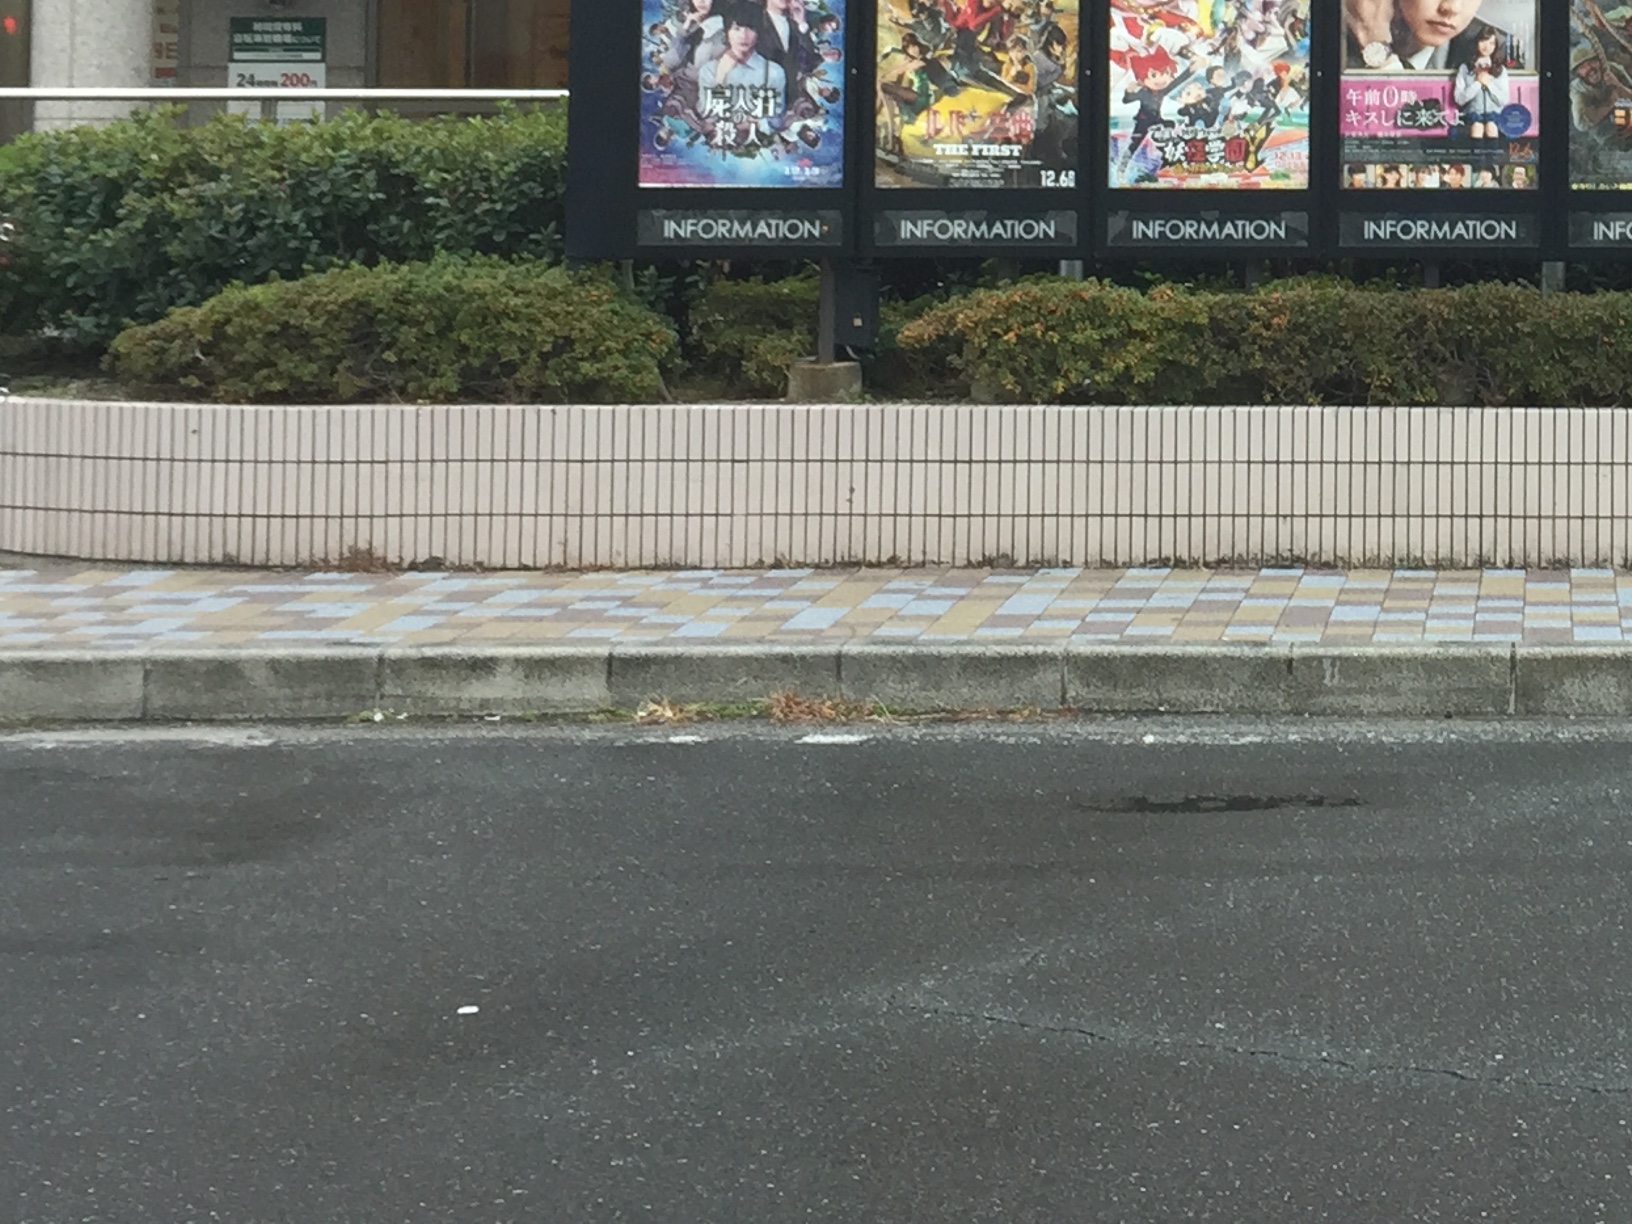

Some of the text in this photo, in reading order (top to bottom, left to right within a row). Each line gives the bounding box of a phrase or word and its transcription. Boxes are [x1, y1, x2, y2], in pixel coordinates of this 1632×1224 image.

[1345, 108, 1465, 127] キスしに来てよ
[933, 144, 1022, 157] THE FIRST
[663, 219, 821, 240] INFORMATION
[900, 219, 1056, 240] INFORMATION
[1132, 219, 1286, 240] INFORMATION
[1363, 219, 1517, 240] INFORMATION
